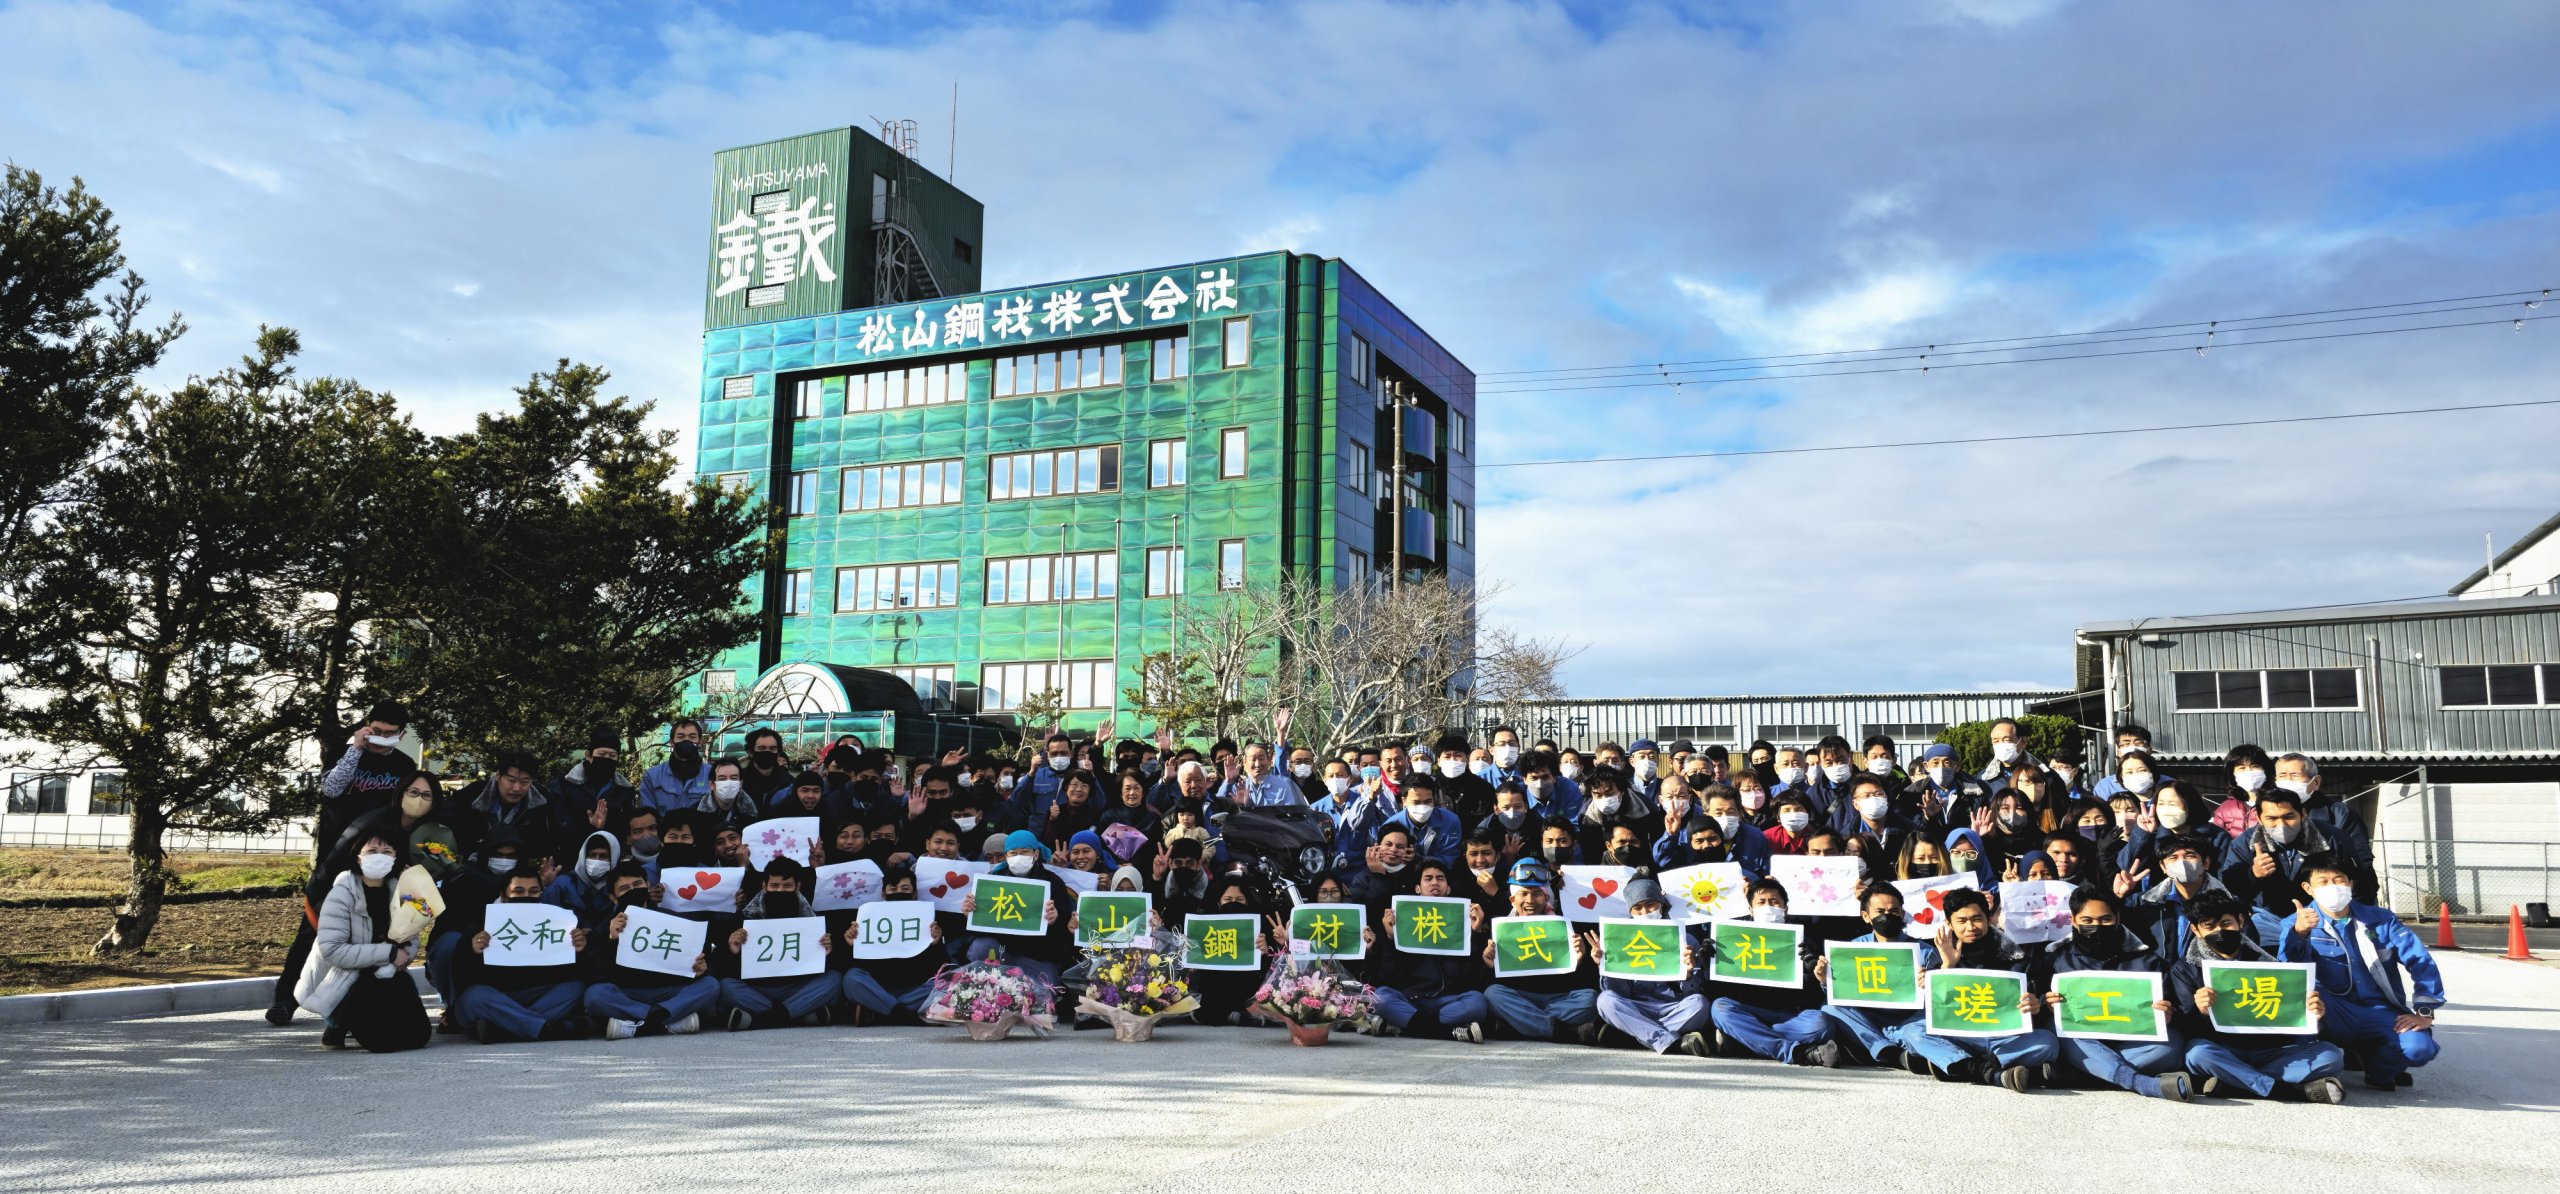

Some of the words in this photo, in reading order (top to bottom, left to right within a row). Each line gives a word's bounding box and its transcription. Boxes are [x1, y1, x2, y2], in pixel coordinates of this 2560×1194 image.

[732, 162, 829, 192] MATSUYAMA
[347, 769, 400, 795] Marin
[988, 887, 1026, 923] 松
[1097, 906, 1129, 935] 山
[491, 917, 567, 953] 令和
[860, 917, 922, 945] 19日
[1309, 915, 1343, 949] 材
[1412, 906, 1447, 944] 株
[630, 926, 683, 961] 6年
[756, 932, 803, 963] 2月
[1203, 926, 1238, 960] 鋼
[1516, 927, 1552, 963] 式
[1622, 930, 1662, 969] 会
[1734, 934, 1777, 972] 社
[1856, 956, 1891, 995] 匝
[1954, 982, 2000, 1024] 瑳
[2085, 991, 2131, 1023] 工
[2234, 976, 2284, 1020] 場
